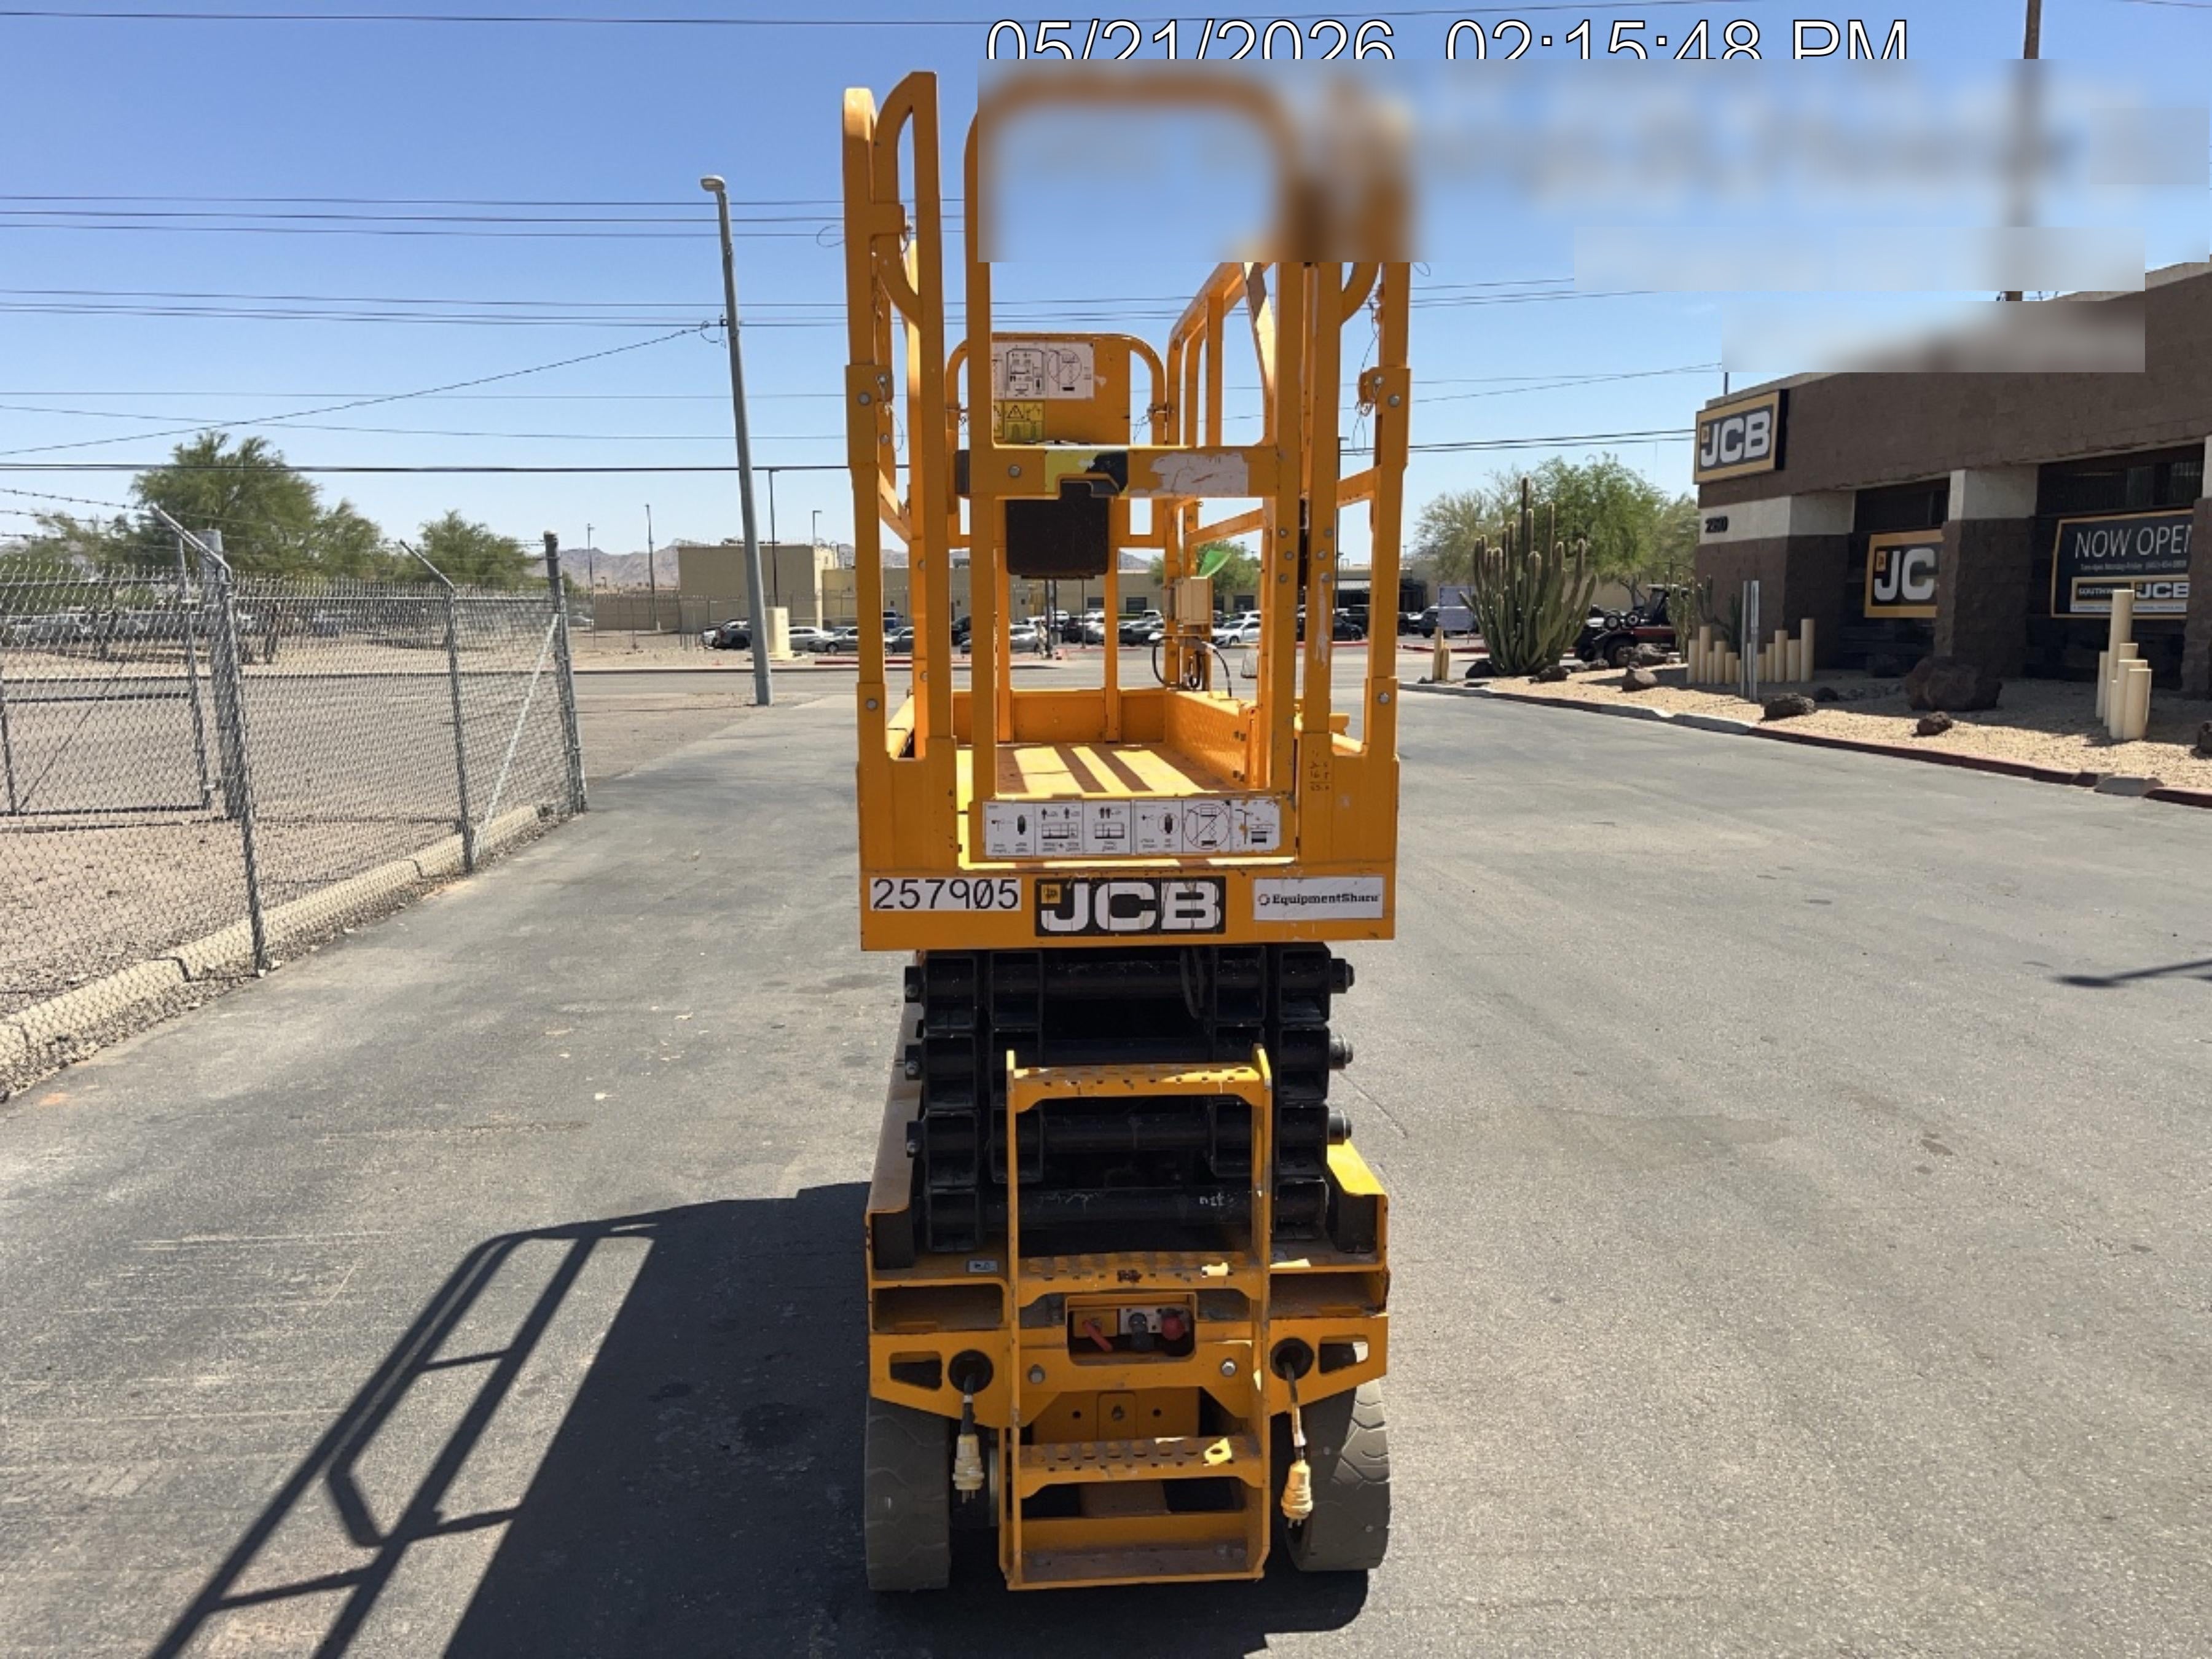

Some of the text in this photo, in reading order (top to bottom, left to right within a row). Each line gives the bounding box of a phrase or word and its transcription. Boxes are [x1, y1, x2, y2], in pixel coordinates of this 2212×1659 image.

[1701, 410, 1770, 467] JCB
[2075, 528, 2132, 559] NOW
[1874, 548, 1935, 600] JC
[2136, 582, 2190, 598] JCB
[873, 879, 1018, 909] 257905
[1041, 882, 1221, 931] JCB
[1272, 893, 1378, 906] EquipmentShare
